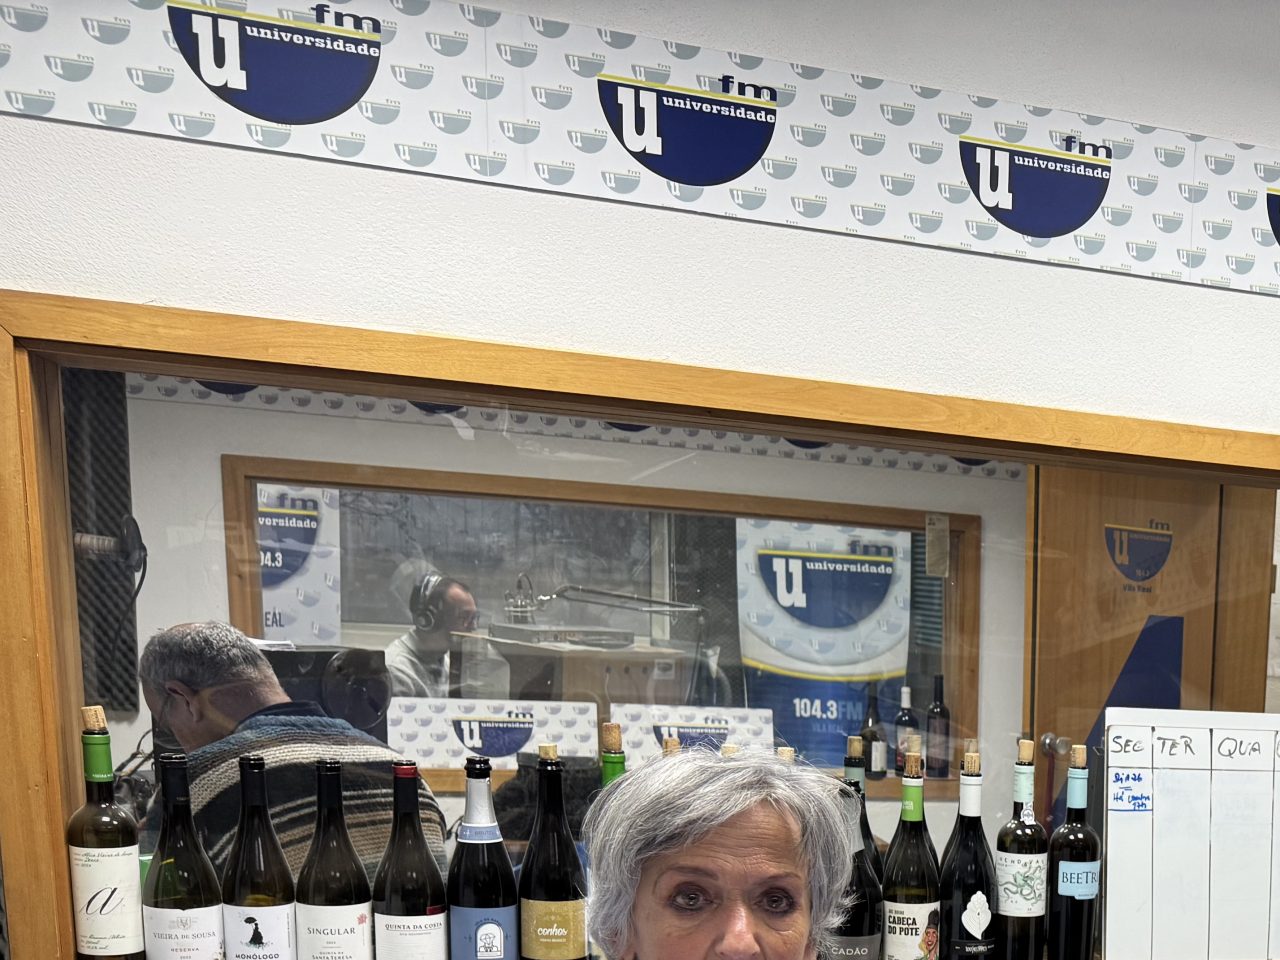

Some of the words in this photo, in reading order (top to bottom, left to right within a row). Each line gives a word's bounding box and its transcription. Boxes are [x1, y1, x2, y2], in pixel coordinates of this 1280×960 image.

[311, 4, 381, 33] fm
[192, 14, 247, 90] u
[245, 25, 380, 57] universidade
[718, 75, 777, 101] fm
[617, 86, 662, 155] u
[662, 96, 776, 123] universidade
[1062, 136, 1112, 159] fm
[976, 147, 1012, 210] u
[1013, 155, 1110, 179] universidade
[277, 493, 318, 510] fm
[849, 540, 893, 556] fm
[806, 561, 892, 574] universidade
[773, 558, 806, 608] u
[461, 721, 482, 748] u
[1157, 735, 1196, 756] TER
[1218, 737, 1261, 759] QUA
[307, 927, 356, 935] SINGULAR
[887, 915, 917, 927] CABEÇA
[887, 925, 897, 935] DO
[900, 926, 920, 936] POTE
